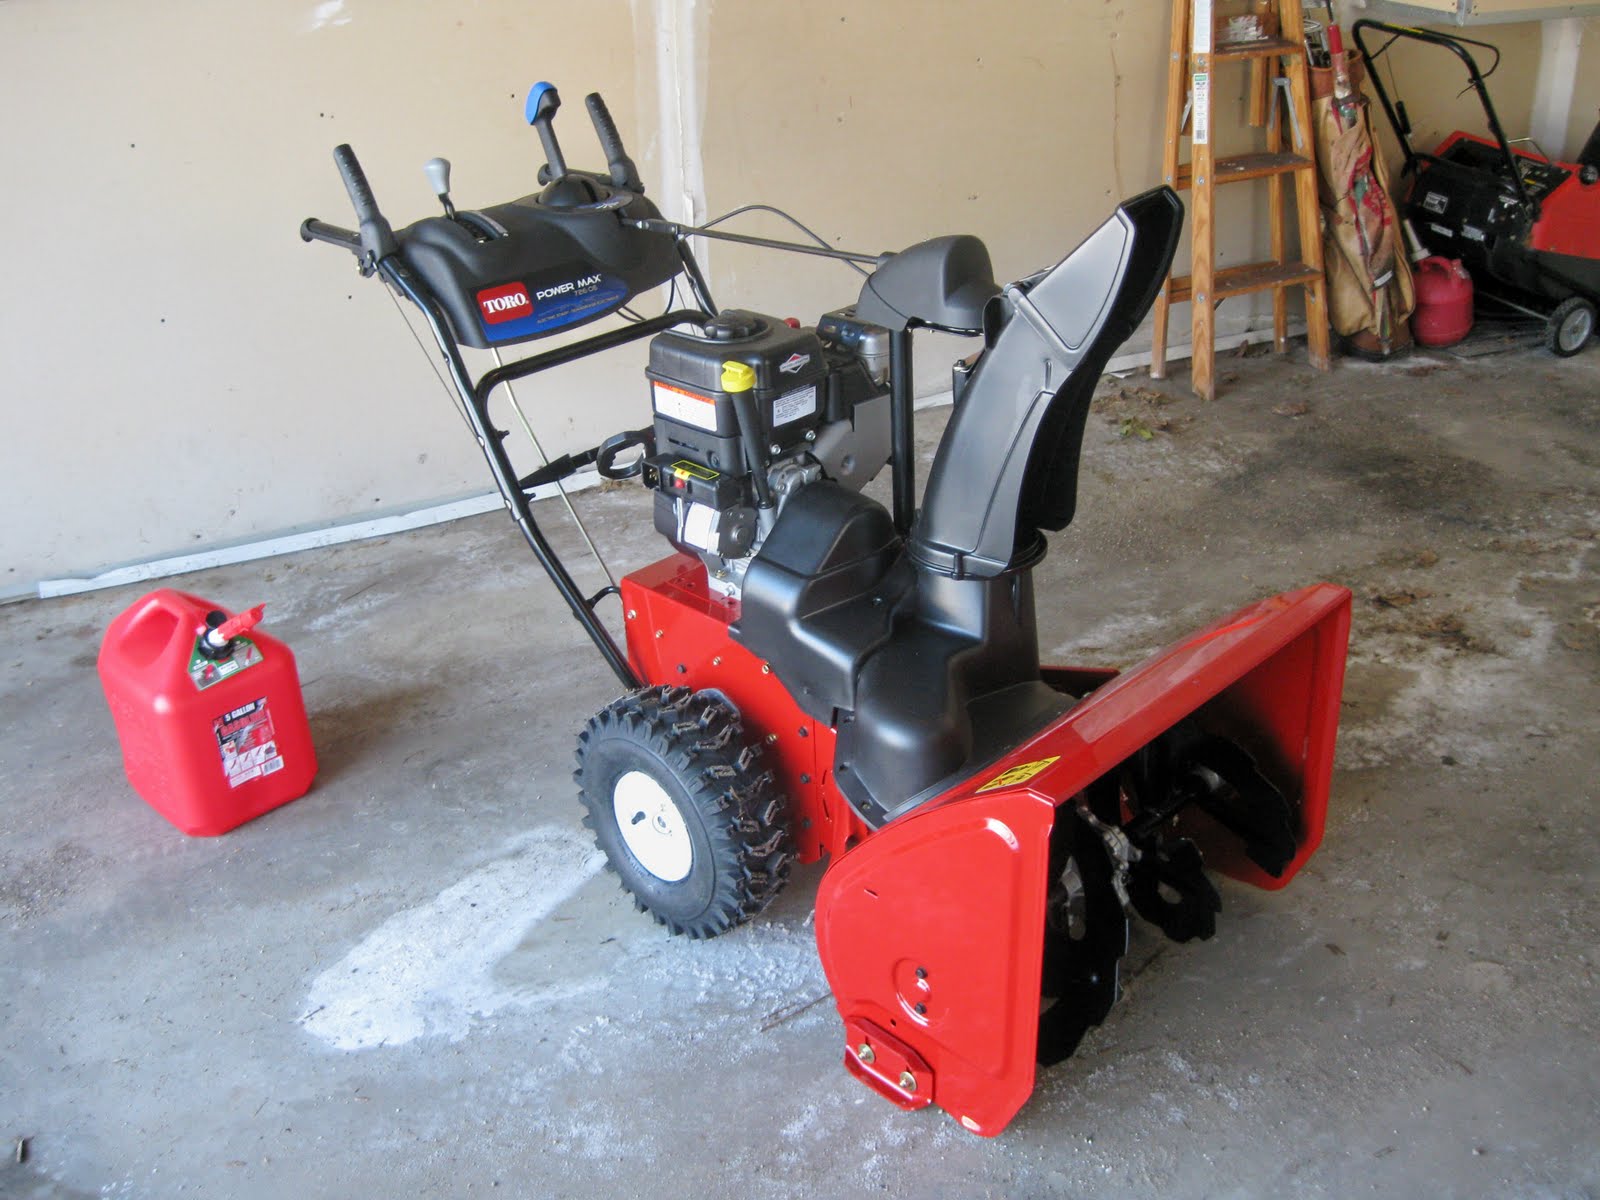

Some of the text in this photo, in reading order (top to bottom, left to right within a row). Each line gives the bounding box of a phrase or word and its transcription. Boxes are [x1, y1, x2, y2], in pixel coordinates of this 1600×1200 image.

[536, 283, 575, 300] POWER
[577, 274, 601, 288] MAX
[483, 292, 527, 314] TORO
[225, 713, 231, 722] 5
